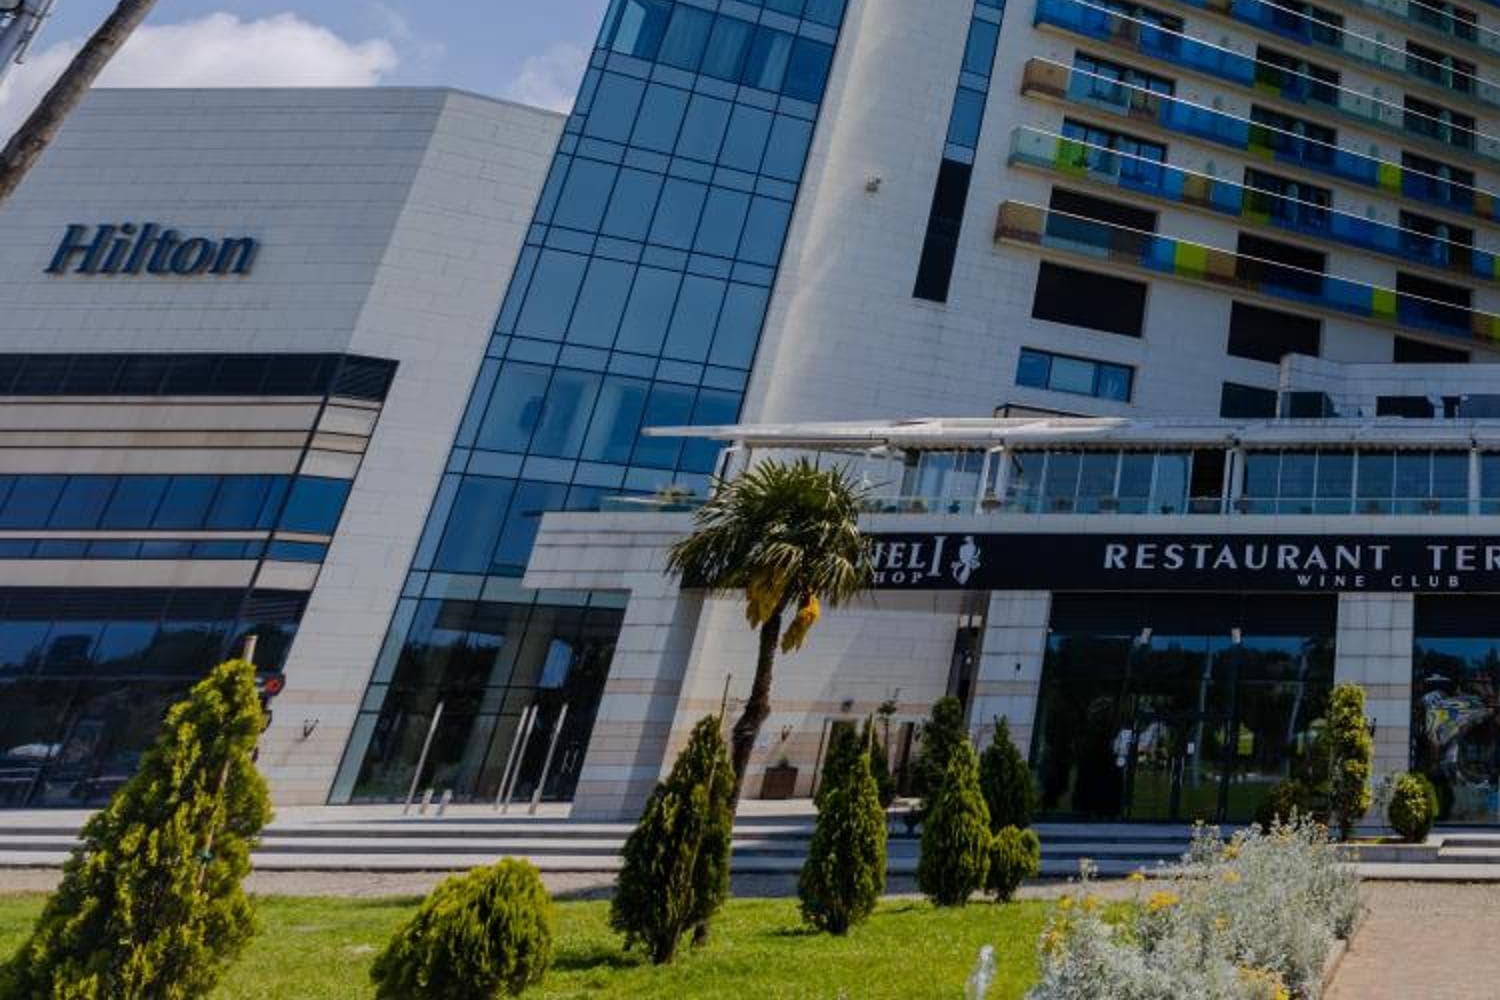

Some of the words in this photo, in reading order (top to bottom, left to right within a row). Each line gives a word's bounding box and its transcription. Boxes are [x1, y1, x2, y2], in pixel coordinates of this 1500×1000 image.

[43, 222, 261, 276] Hilton
[1103, 543, 1391, 570] RESTAURANT
[872, 571, 923, 583] HOP
[1296, 575, 1365, 587] WINE
[1391, 575, 1460, 587] CLUB
